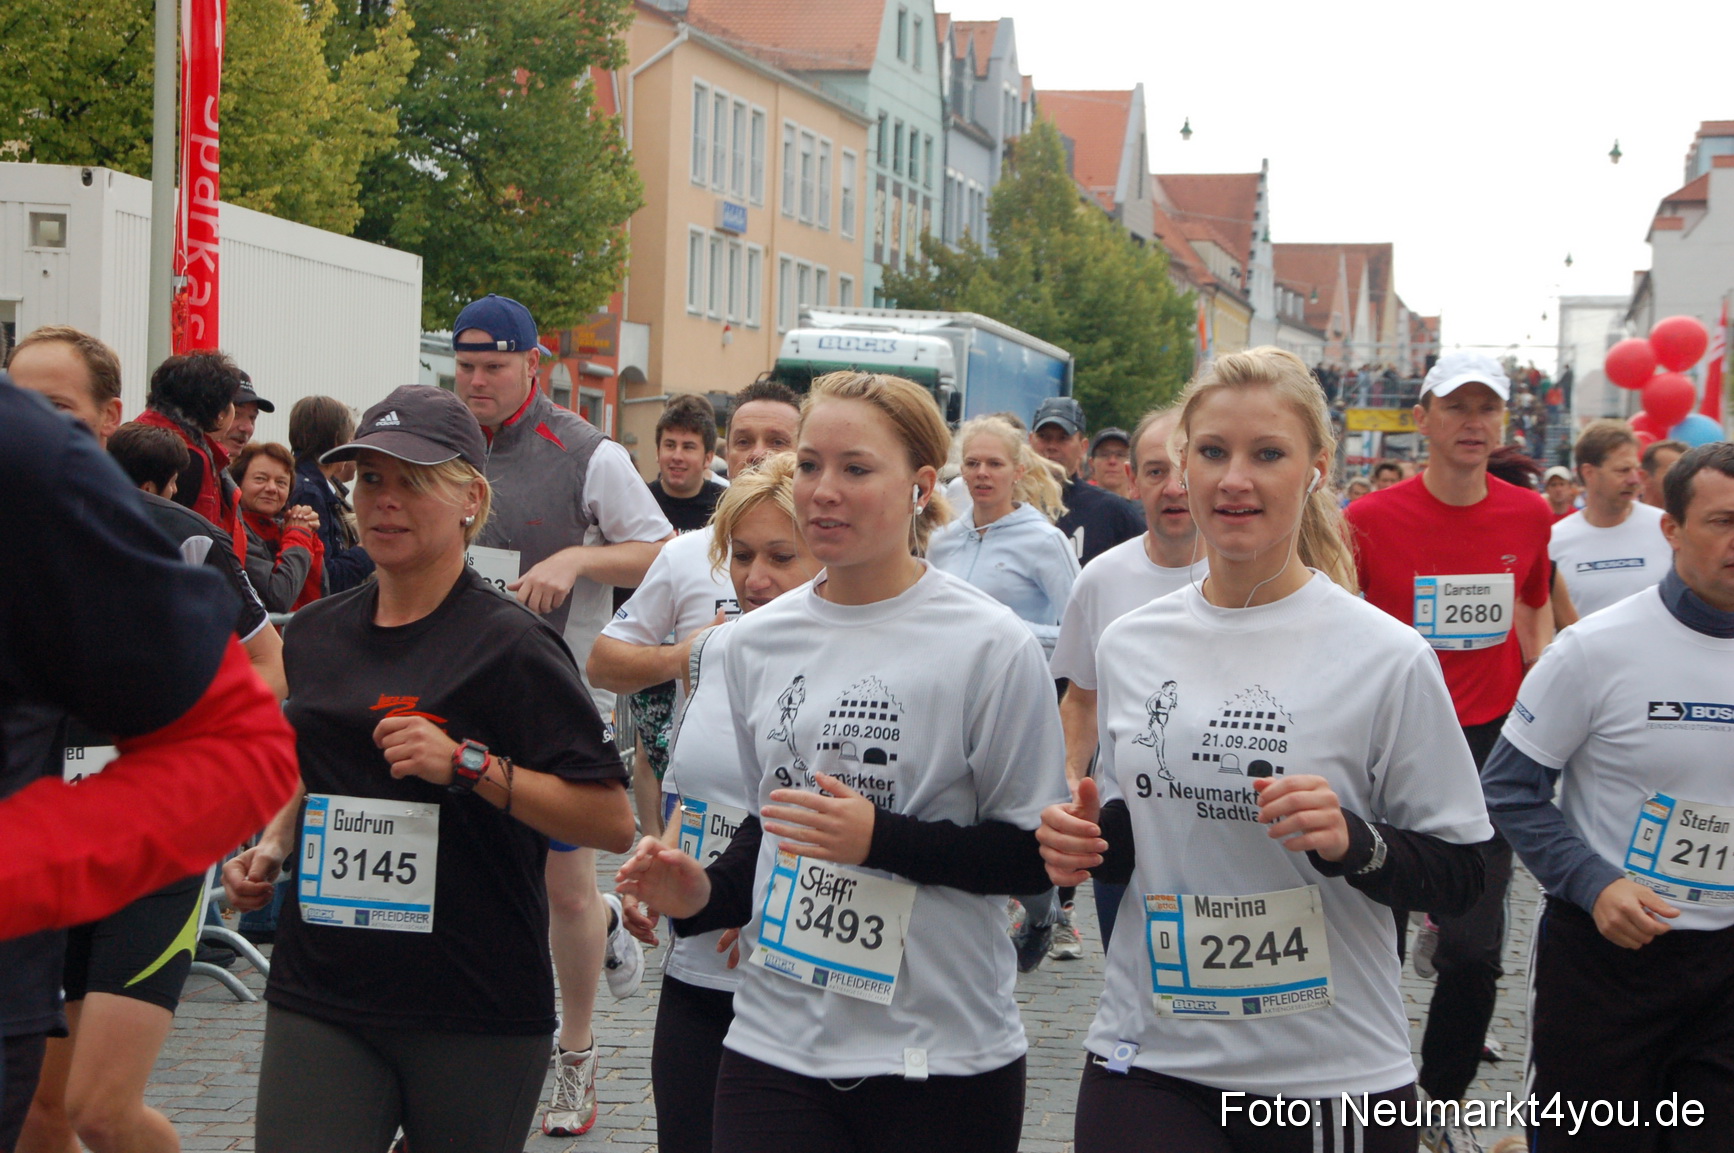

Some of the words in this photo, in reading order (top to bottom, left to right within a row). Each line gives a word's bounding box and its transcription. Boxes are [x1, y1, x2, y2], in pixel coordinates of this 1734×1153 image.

[818, 335, 897, 354] BOCK
[1444, 583, 1491, 596] Carsten
[1444, 603, 1503, 624] 2680
[822, 723, 901, 742] 21.09.2008
[1201, 732, 1288, 754] 21.09.2008
[774, 766, 801, 788] 9.
[1135, 773, 1163, 798] 9.
[333, 808, 395, 836] Gudrun
[1679, 808, 1731, 834] Stefan
[1642, 827, 1654, 842] C
[307, 842, 315, 860] D
[1670, 838, 1734, 871] 211
[331, 846, 417, 885] 3145
[800, 865, 858, 906] Stäffi
[371, 910, 430, 925] PFLEIDERER
[1194, 895, 1267, 919] Marina
[795, 896, 885, 951] 3493
[1160, 931, 1170, 950] D
[1200, 926, 1309, 970] 2244
[829, 971, 892, 996] PFLEIDERER
[1172, 999, 1217, 1011] BOCK
[1262, 987, 1330, 1007] PFLEIDERER
